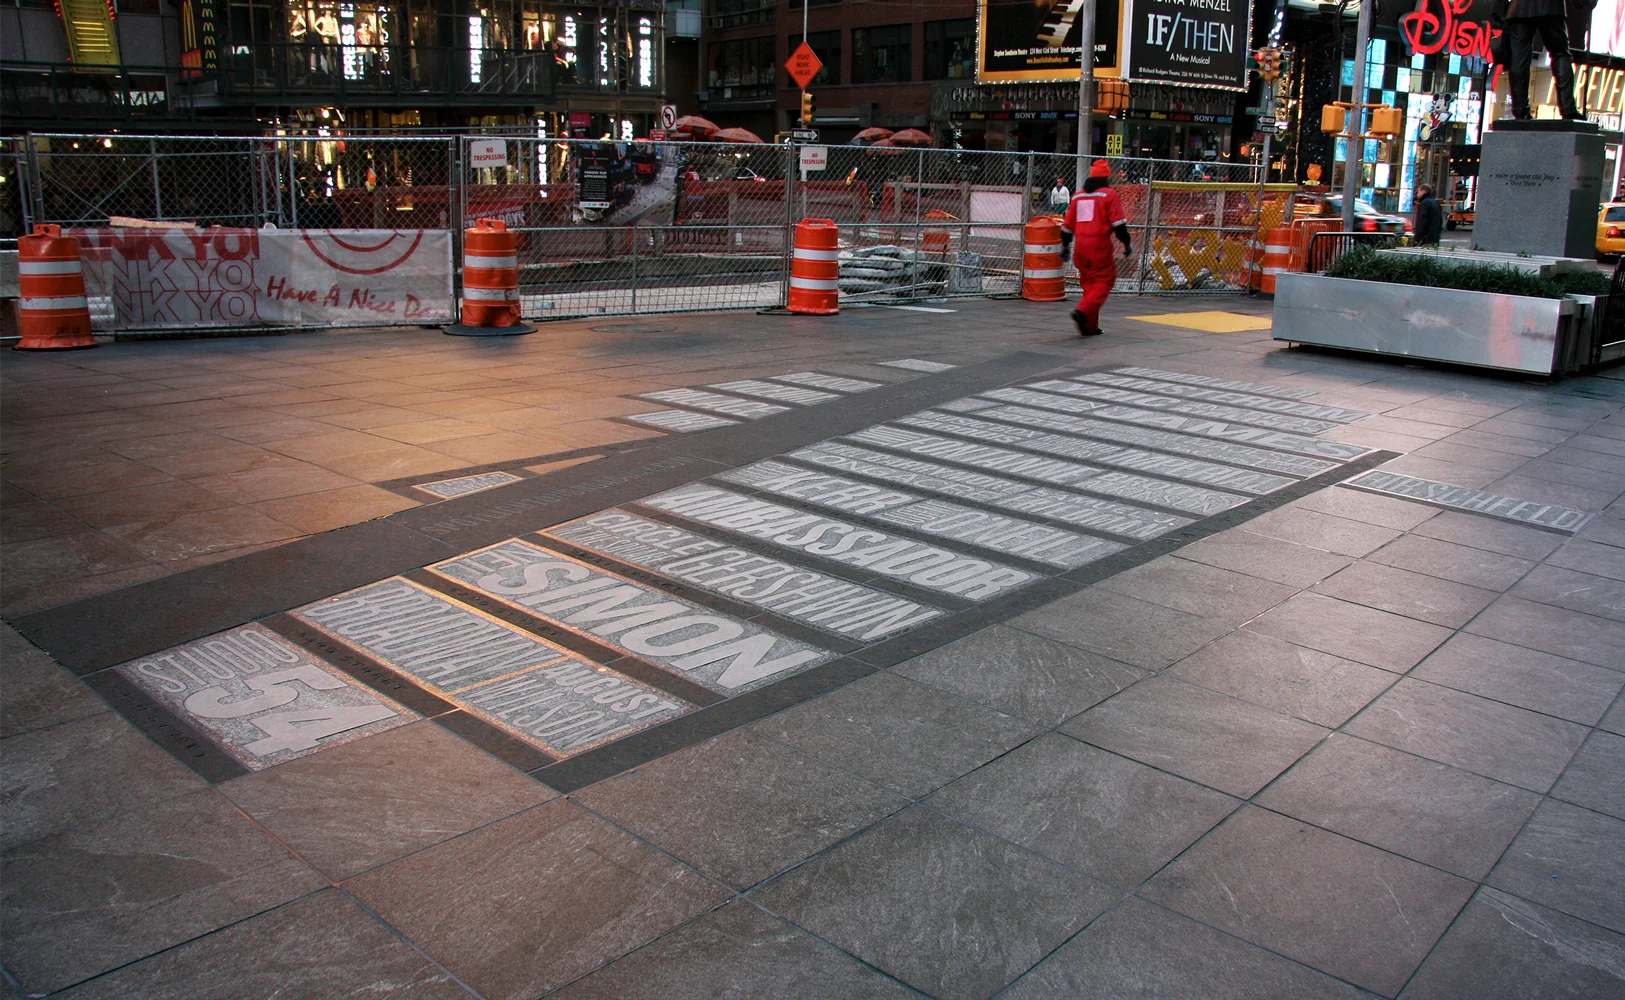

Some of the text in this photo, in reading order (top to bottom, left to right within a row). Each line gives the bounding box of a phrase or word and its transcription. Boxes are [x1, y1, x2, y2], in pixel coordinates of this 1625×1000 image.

[1146, 12, 1234, 54] IF/THEN
[1176, 54, 1189, 62] New
[1190, 56, 1210, 64] Musical
[1194, 114, 1215, 123] SONY
[267, 276, 318, 300] Have
[323, 284, 341, 306] A
[348, 288, 396, 313] Nice
[640, 388, 791, 416] PALACE
[1022, 379, 1183, 407] LYRIC
[1094, 378, 1370, 422] AMSTERDAM
[894, 417, 1024, 442] MARQUIS
[1086, 411, 1373, 458] JAMES
[787, 450, 1006, 501] LONGACRE
[860, 454, 1037, 493] BARRYMORE
[888, 436, 1105, 483] FONTANNE
[1096, 450, 1281, 492] IMPERIAL
[750, 470, 917, 514] KERR
[1027, 489, 1147, 517] SAMUEL
[1094, 472, 1244, 504] BROOKS
[582, 513, 722, 555] CIRCLE
[994, 494, 1168, 537] FRIEDMAN
[568, 530, 620, 545] THE
[593, 539, 679, 566] SQUARE
[642, 490, 1033, 599] AMBASSADOR
[916, 511, 1104, 565] O'NEILL
[655, 548, 941, 639] GERSHWIN
[300, 586, 563, 685] BROADWAY
[436, 542, 824, 689] NEIL SIMON
[138, 629, 300, 692] STUDIO
[183, 664, 398, 756] 54
[461, 675, 632, 750] WILSON
[534, 662, 681, 720] AUGUST
